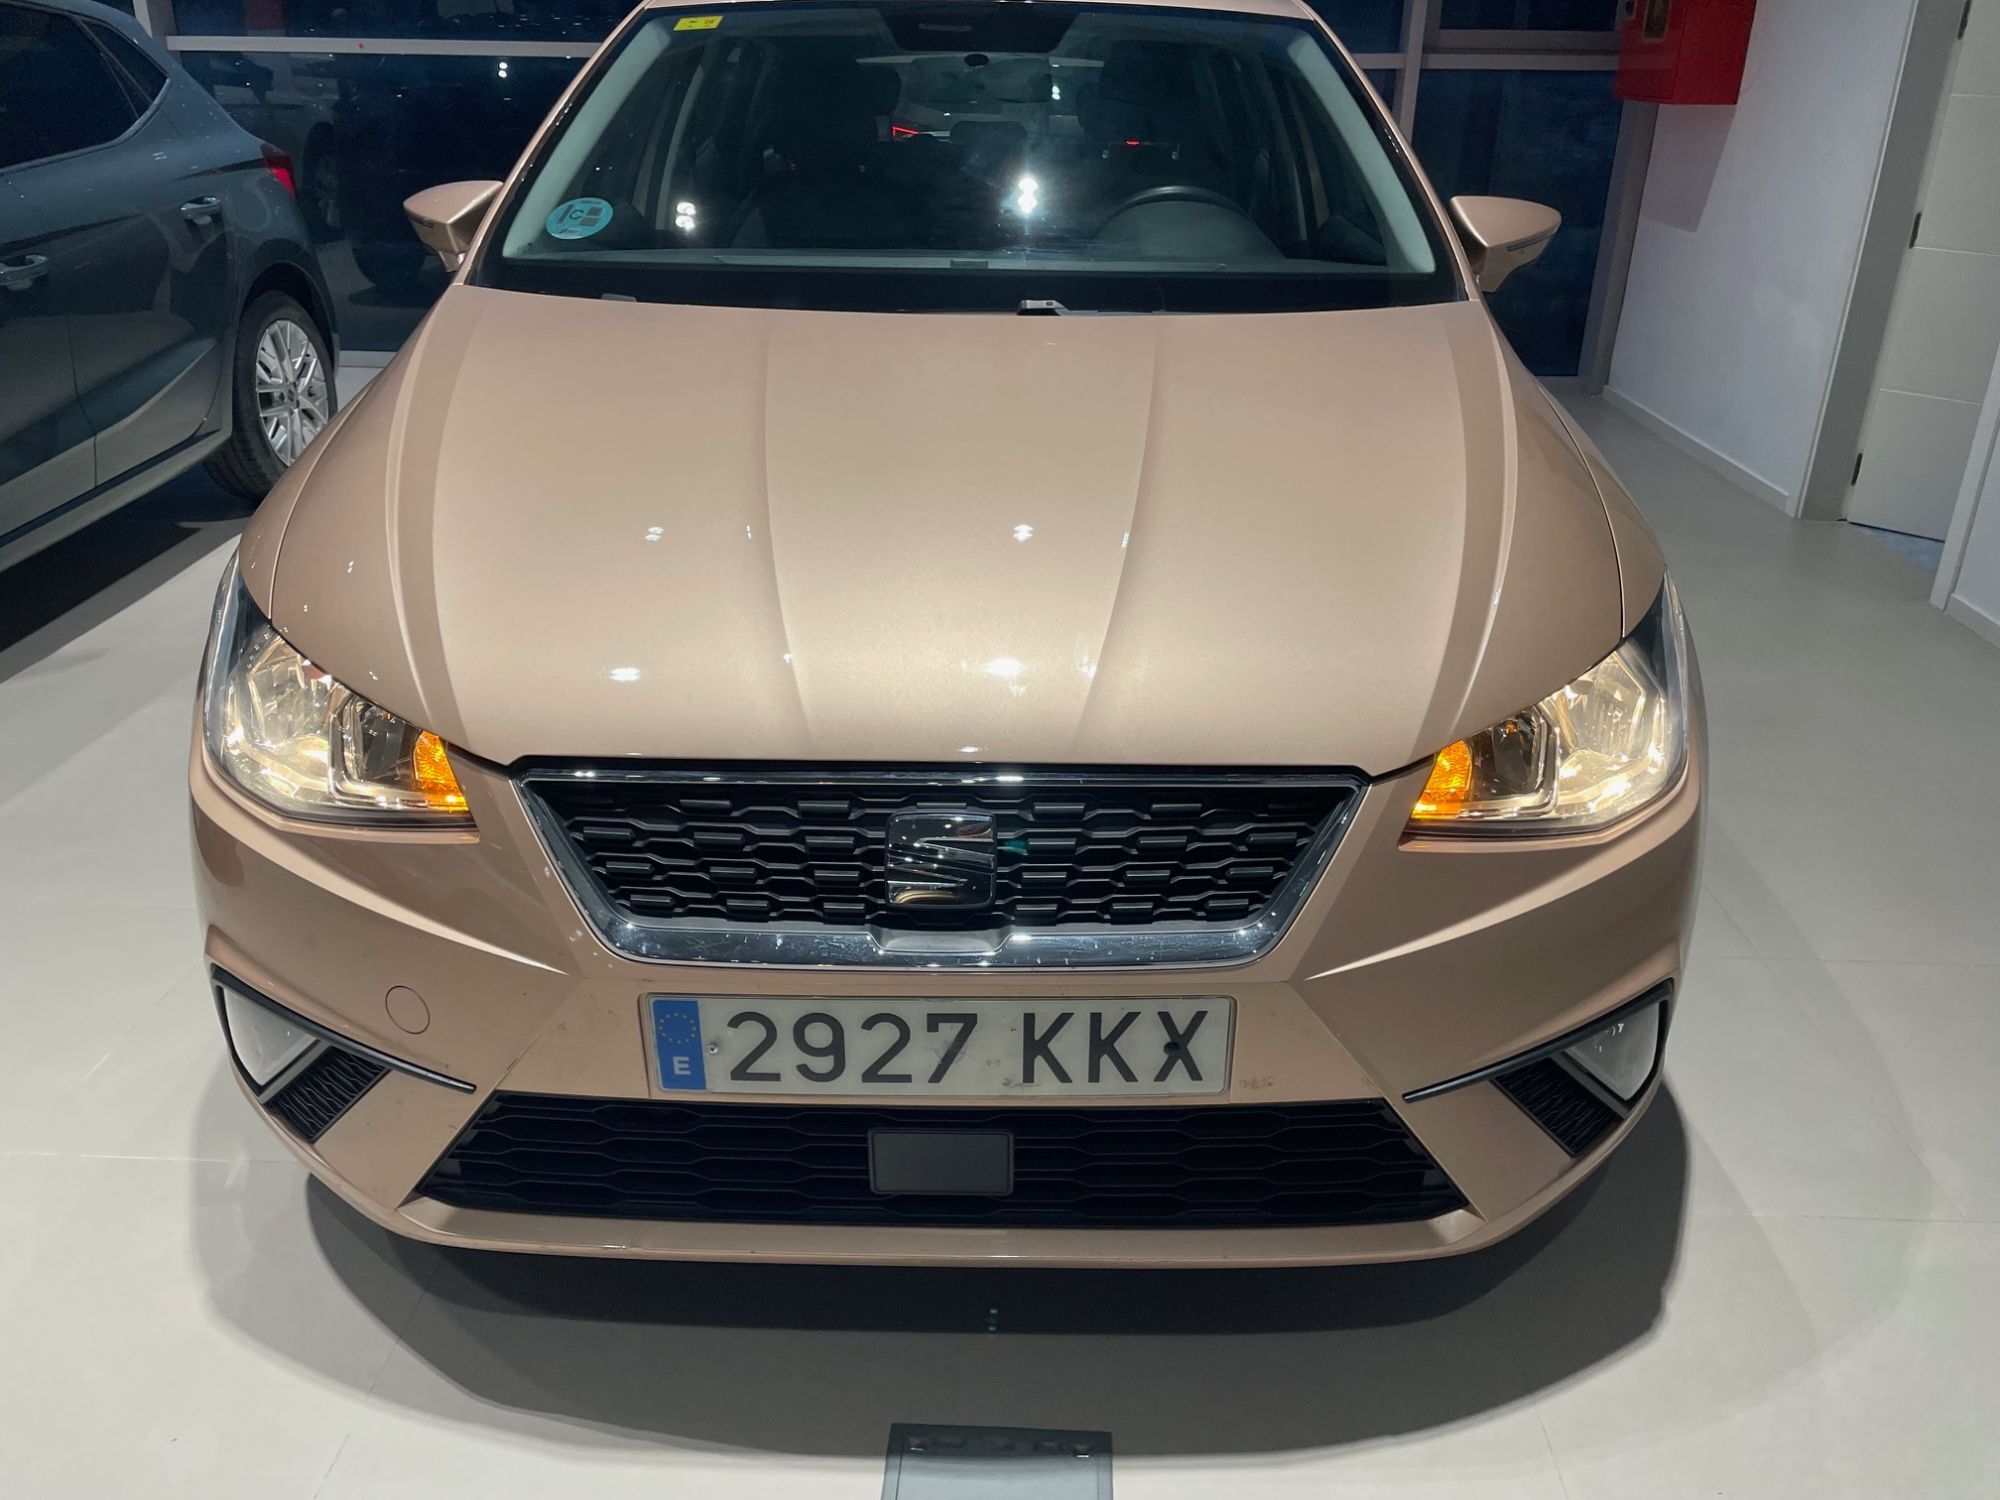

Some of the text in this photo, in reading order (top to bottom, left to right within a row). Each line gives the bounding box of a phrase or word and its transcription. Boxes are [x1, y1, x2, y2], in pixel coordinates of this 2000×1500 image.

[672, 1056, 692, 1076] E
[727, 1010, 1209, 1084] 2927 KKX
